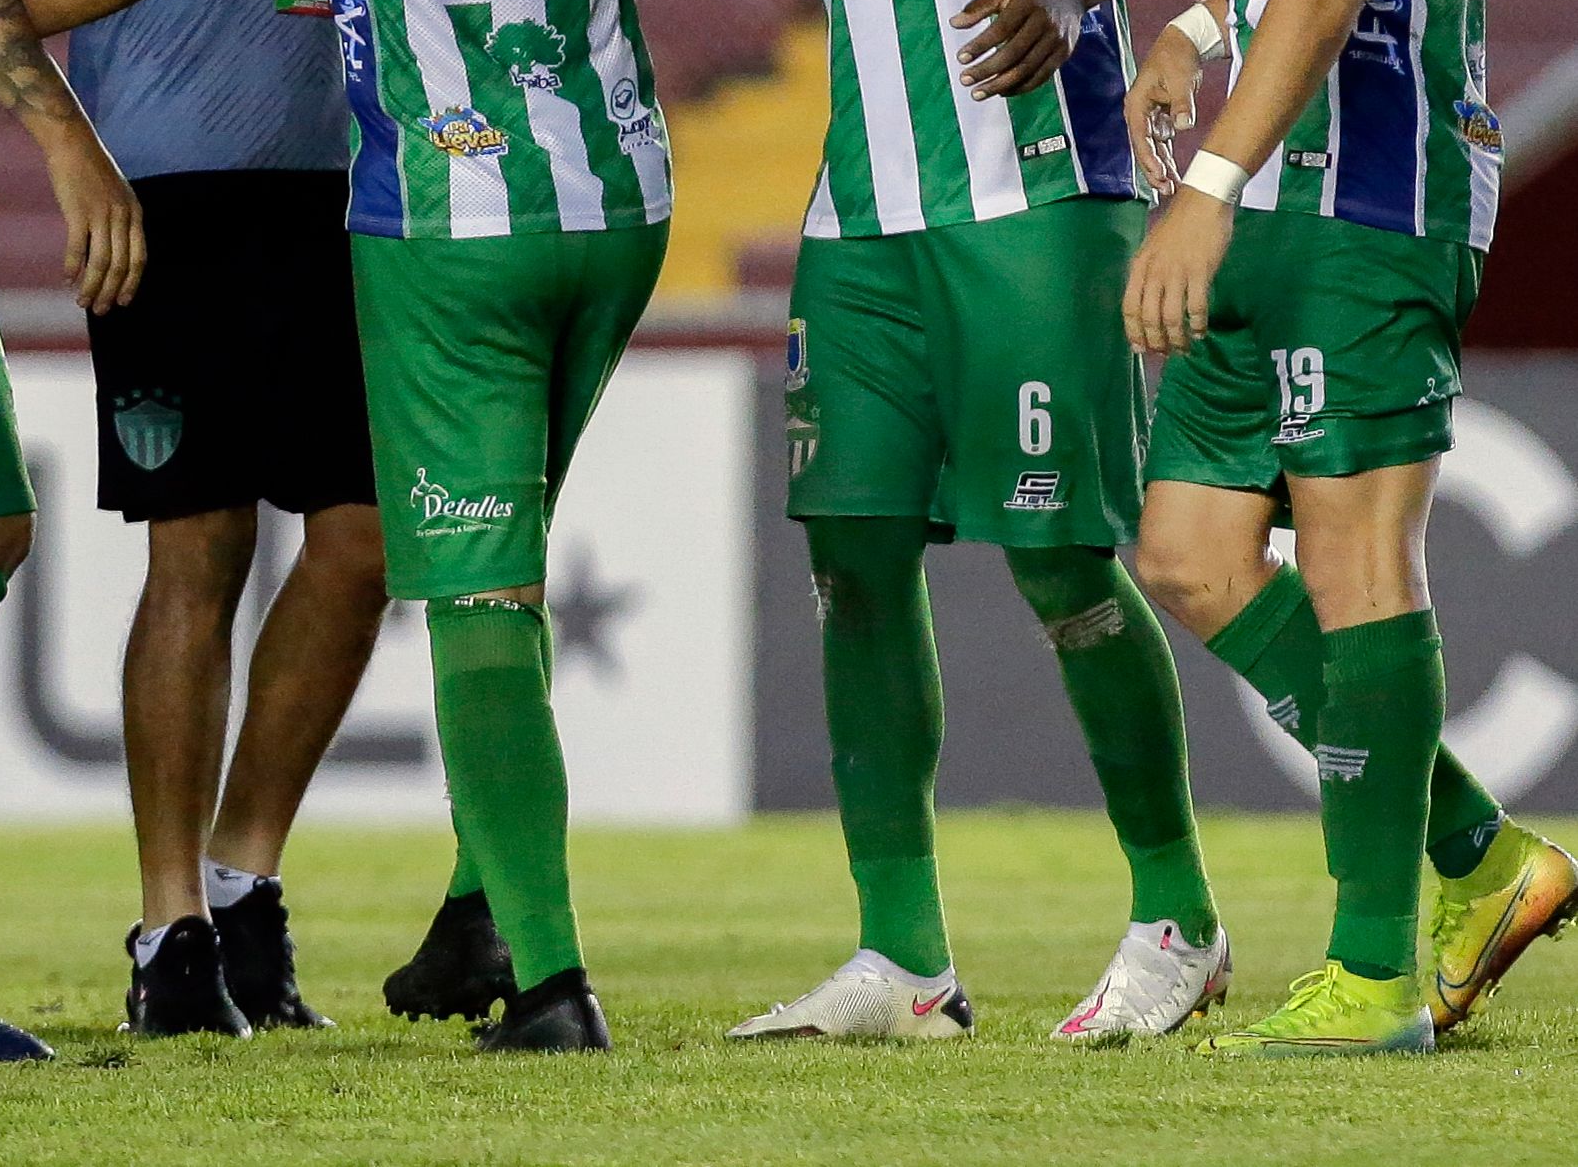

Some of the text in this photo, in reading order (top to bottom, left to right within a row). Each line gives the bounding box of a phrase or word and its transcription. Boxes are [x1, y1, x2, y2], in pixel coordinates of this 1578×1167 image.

[1270, 346, 1326, 414] 19
[1018, 380, 1052, 456] 6
[424, 494, 514, 518] Detalles
